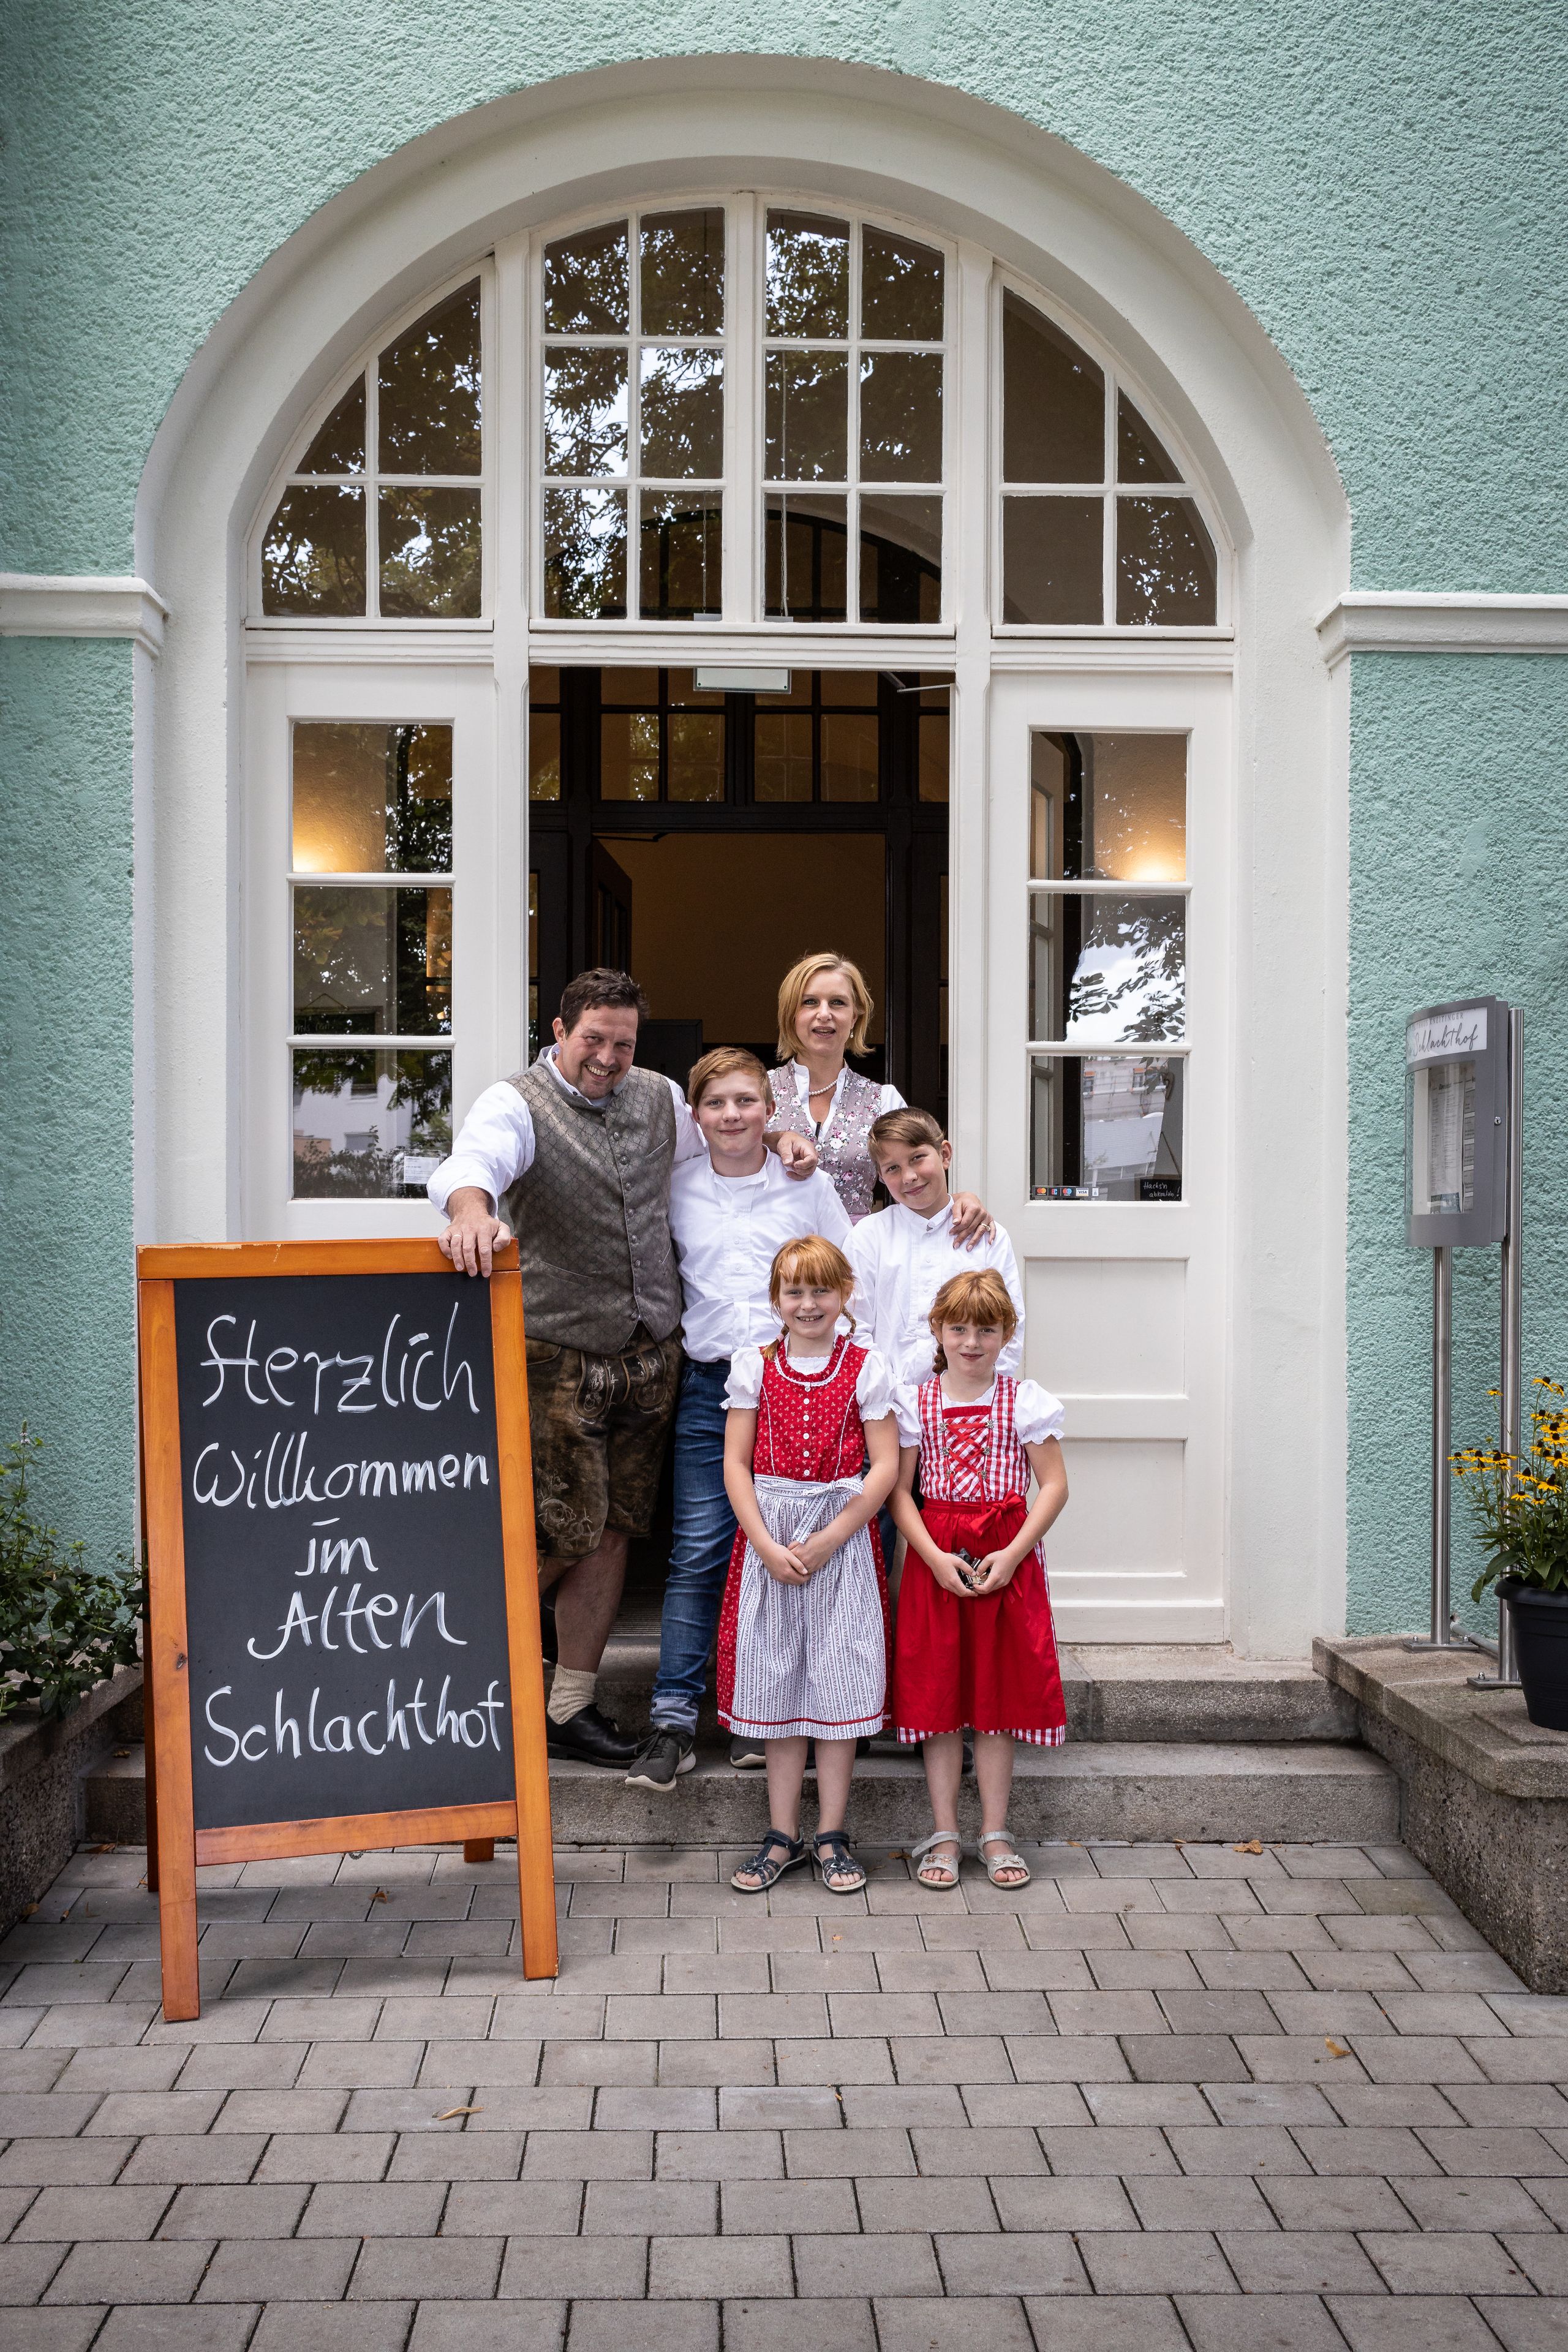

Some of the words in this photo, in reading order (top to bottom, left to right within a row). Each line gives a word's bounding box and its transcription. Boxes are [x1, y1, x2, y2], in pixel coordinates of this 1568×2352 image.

[1430, 1012, 1463, 1025] KNEITINGER
[200, 1302, 480, 1414] Herzlich
[193, 1431, 489, 1509] Willkommen
[295, 1517, 379, 1577] im
[247, 1583, 467, 1660] Alten
[204, 1675, 504, 1767] Schlachthof
